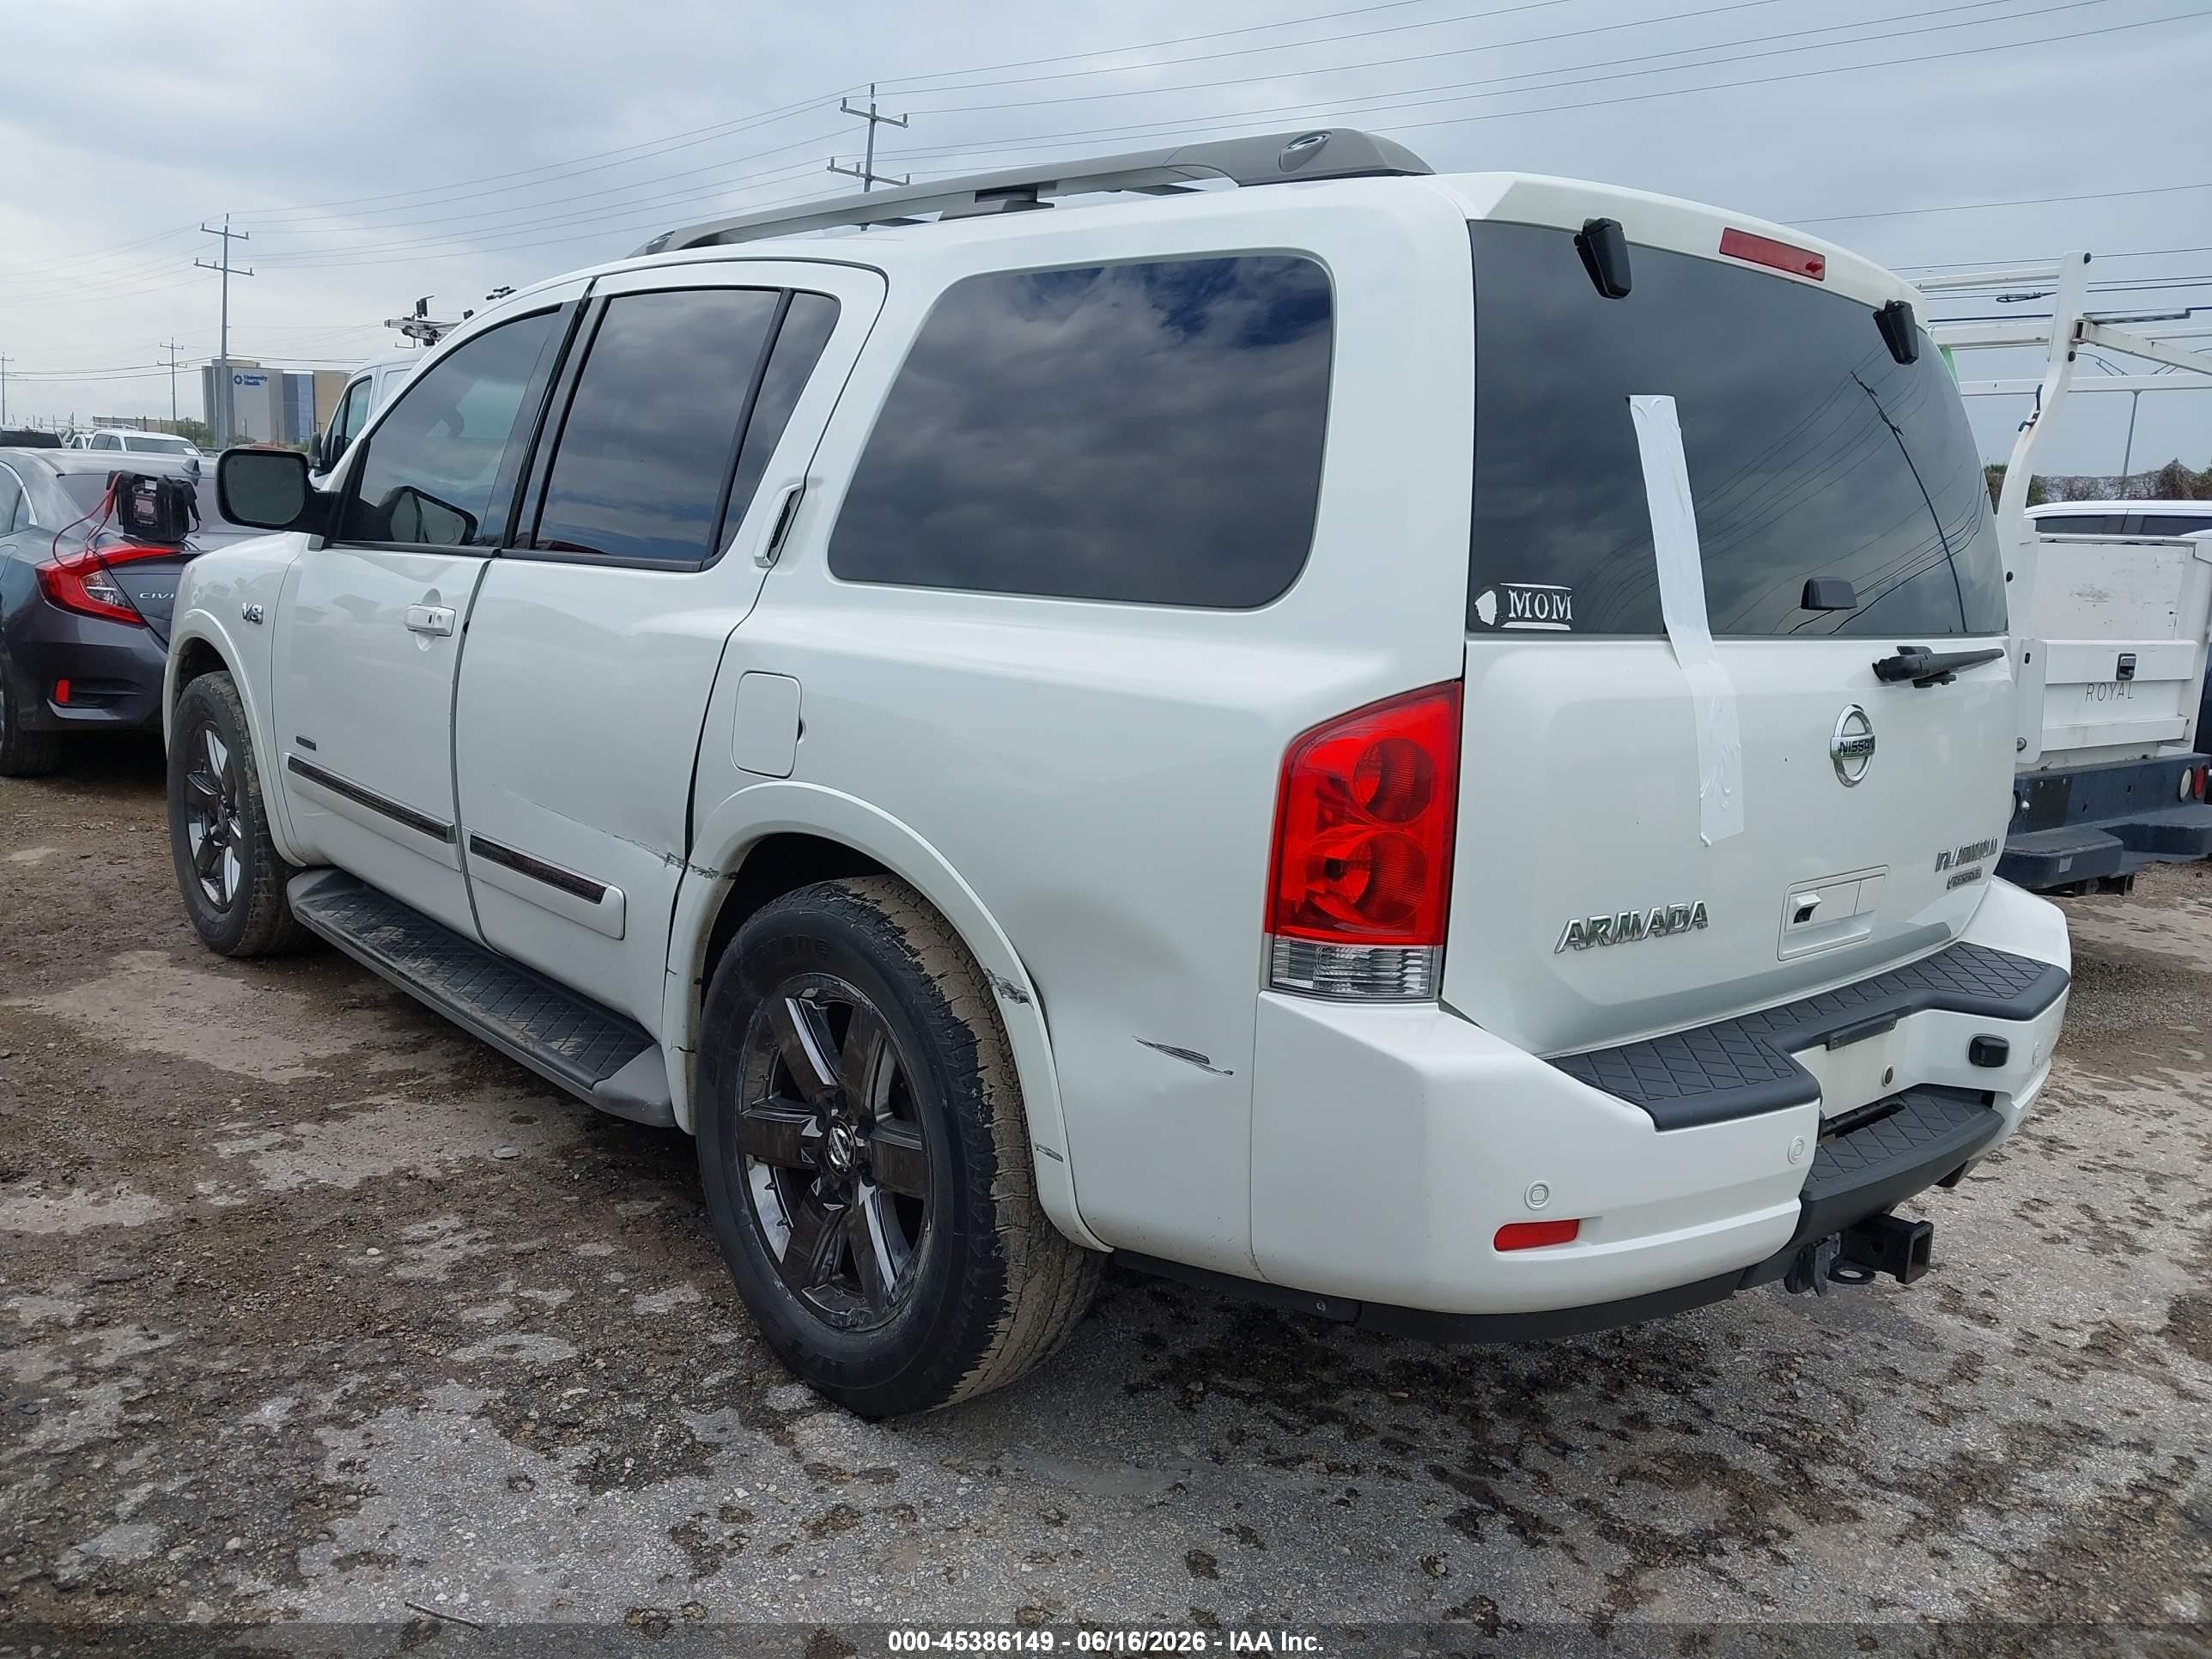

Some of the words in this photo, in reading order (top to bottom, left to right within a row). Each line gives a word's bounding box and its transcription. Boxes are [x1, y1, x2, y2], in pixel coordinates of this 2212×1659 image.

[241, 602, 264, 625] V8
[1508, 588, 1573, 621] MOM
[2085, 681, 2135, 702] ROYAL
[1553, 899, 1709, 954] ARMADA
